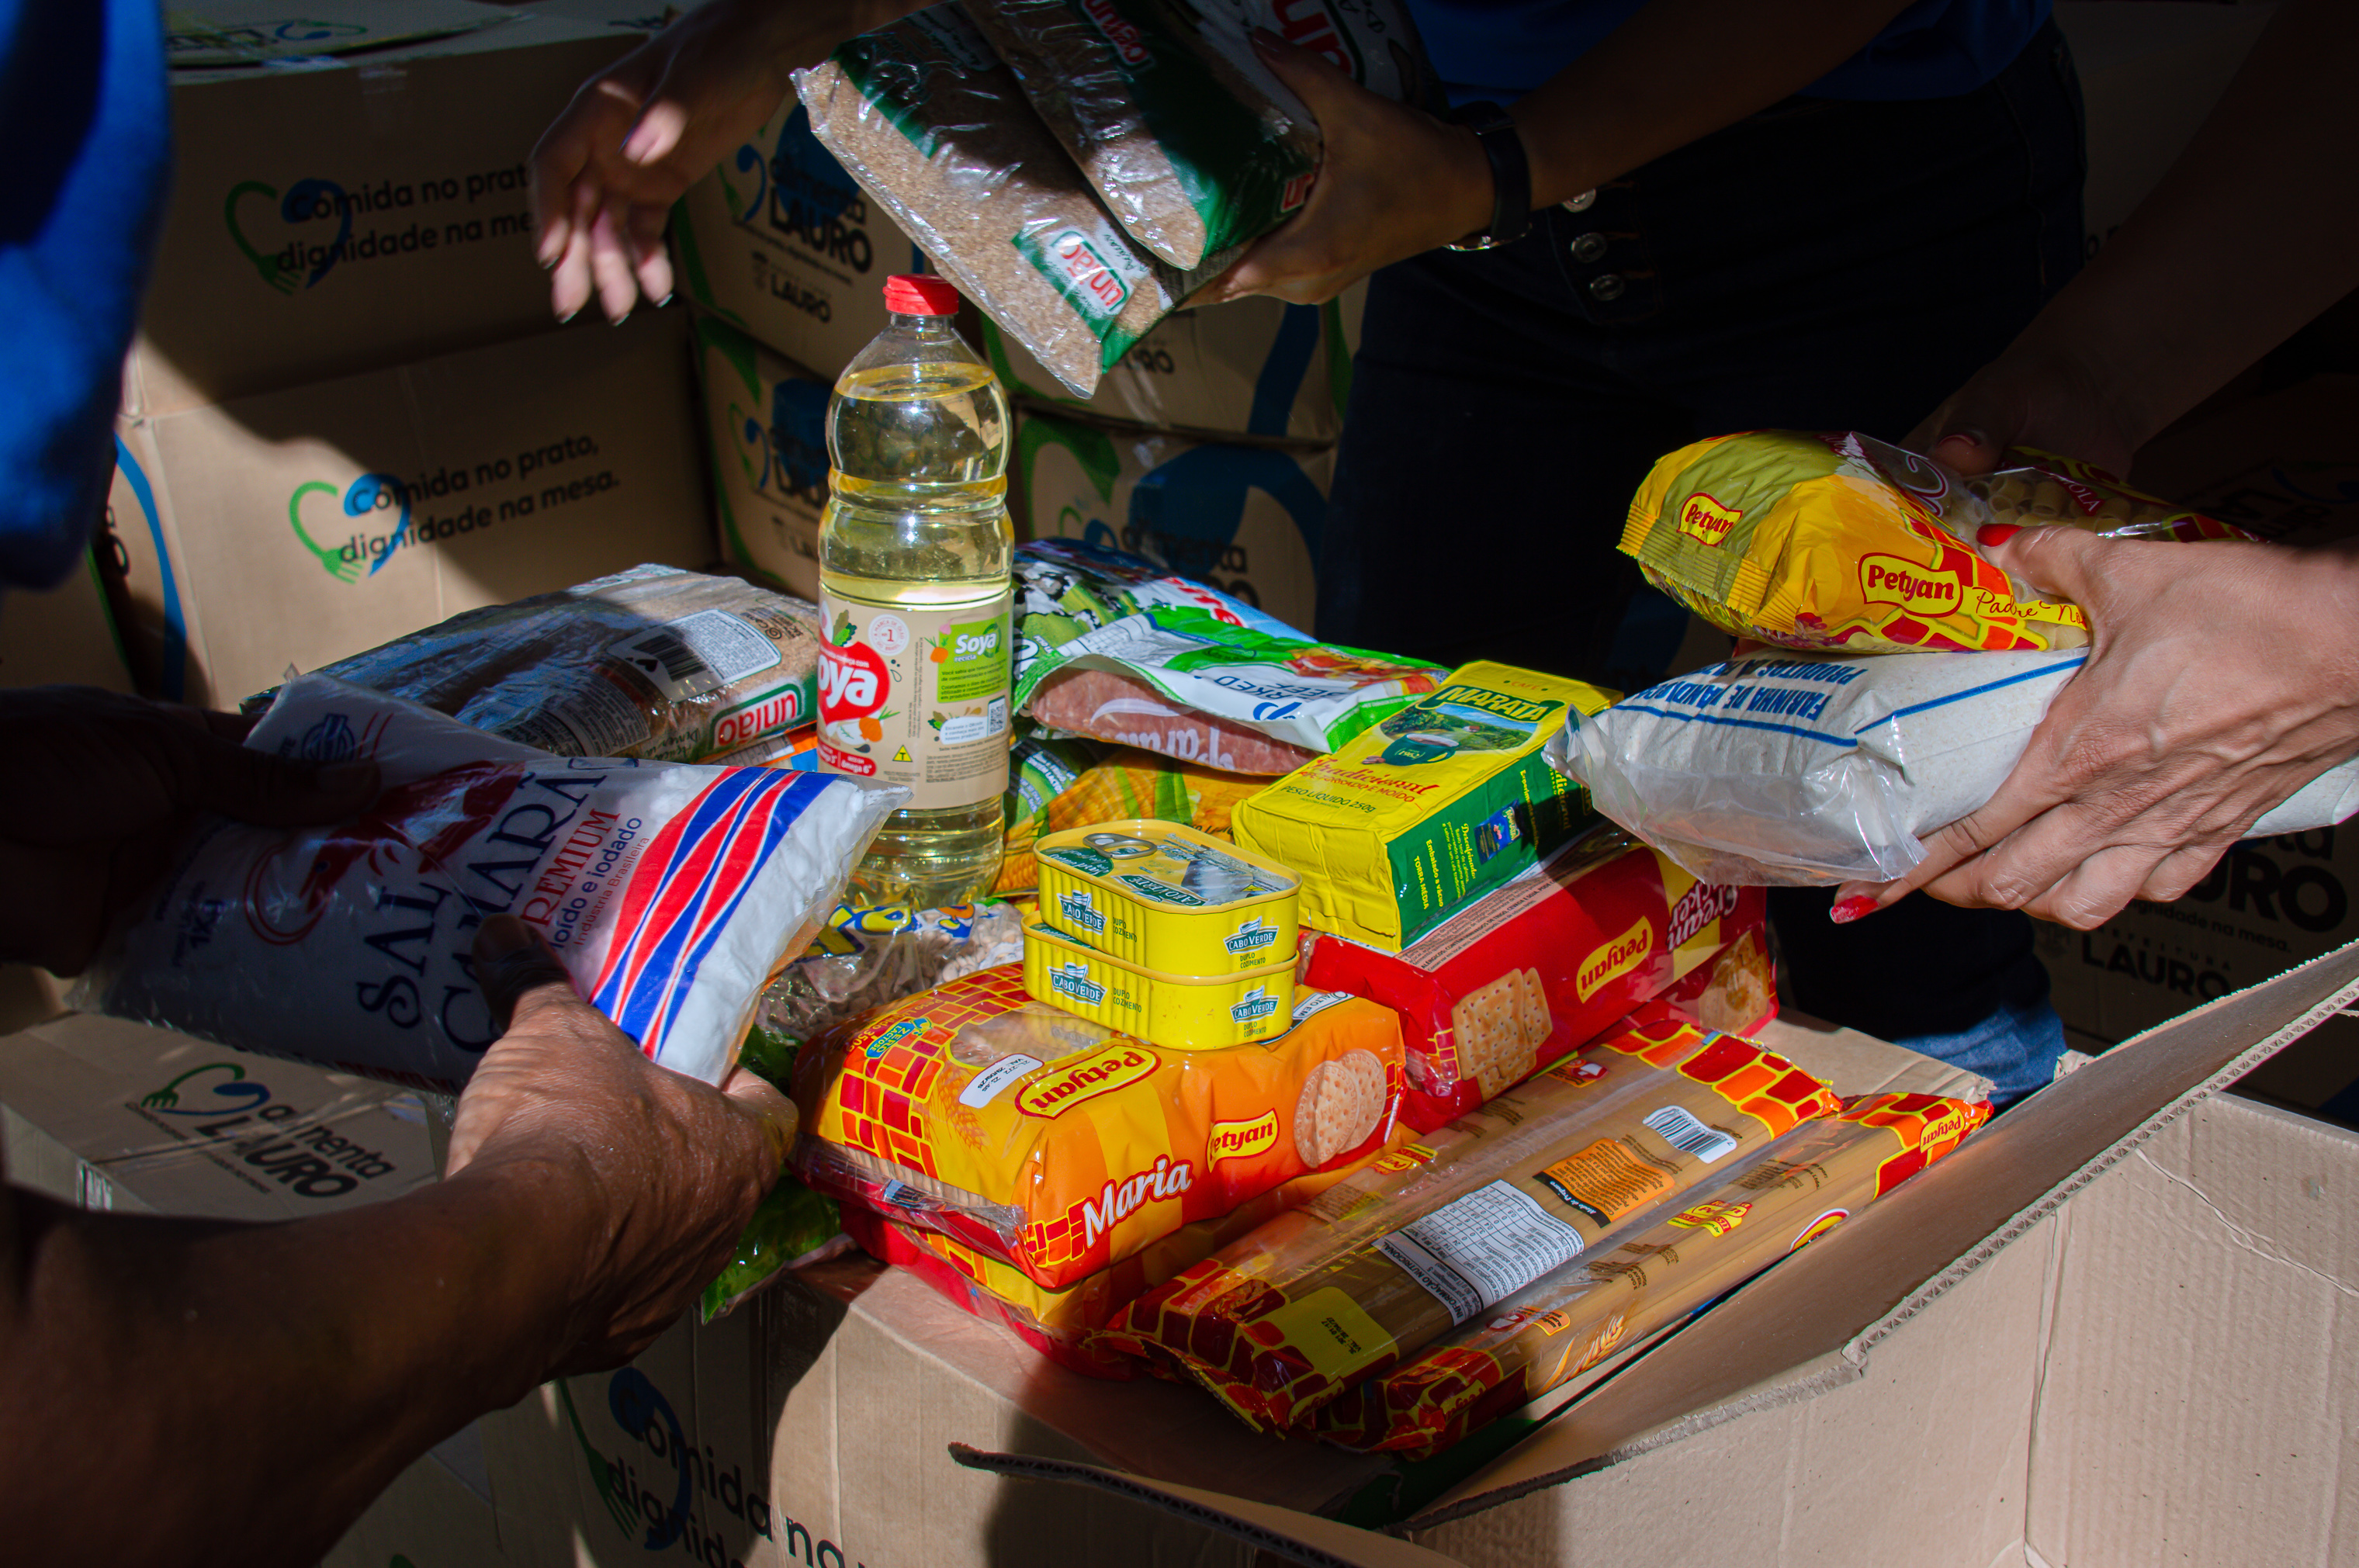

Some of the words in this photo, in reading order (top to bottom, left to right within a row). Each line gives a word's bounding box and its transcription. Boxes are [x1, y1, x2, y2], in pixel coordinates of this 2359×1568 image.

[289, 178, 414, 223] Comida
[422, 176, 459, 204] no
[466, 164, 528, 201] prat
[276, 222, 438, 273] dignidade
[445, 218, 483, 245] na
[770, 186, 874, 274] LAURO
[352, 466, 469, 517] Comida
[474, 454, 512, 485] no
[516, 431, 601, 479] prato,
[338, 504, 493, 566] dignidade
[498, 495, 536, 523] na
[540, 468, 621, 512] mesa.
[1869, 564, 1955, 602] Petyan
[954, 632, 999, 656] Soya
[954, 654, 977, 663] recicla
[817, 653, 878, 709] oya
[1214, 676, 1293, 700] RKED
[1723, 684, 1755, 710] DE
[718, 693, 798, 746] união
[1747, 687, 1832, 722] FARINHA
[1311, 757, 1439, 796] Tradicional
[1281, 785, 1308, 796] PESO
[1308, 789, 1352, 808] LÍQUIDO
[1351, 800, 1377, 815] 250g
[1378, 786, 1416, 803] MOÍDO
[519, 808, 622, 928] REMIUM
[547, 905, 587, 950] oído
[582, 881, 598, 894] e
[594, 816, 643, 879] iodado
[1414, 856, 1424, 882] TORRA
[1419, 884, 1429, 909] MÉDIA
[1426, 840, 1437, 877] Embalado
[1435, 884, 1443, 906] vácuo
[573, 889, 614, 946] Indústria
[611, 836, 651, 888] Brasileira
[1112, 916, 1127, 929] DUPLO
[1112, 926, 1138, 943] COZIMENTO
[356, 882, 453, 1030] SAL
[1239, 952, 1256, 962] DUPLO
[1240, 957, 1266, 969] COZIMENTO
[1581, 927, 1648, 992] Petyan
[2081, 936, 2232, 1001] LAURO
[1112, 987, 1131, 1001] DUPLO
[1113, 996, 1142, 1013] COZIMENTO
[870, 1022, 902, 1054] LACTOSE
[876, 1026, 910, 1054] ZERO
[1243, 1022, 1258, 1031] DUPLO
[1243, 1026, 1267, 1038] COZIMENTO
[1029, 1050, 1148, 1109] Petyan
[1921, 1113, 1963, 1148] Petyan
[194, 1116, 358, 1197] LURO
[1083, 1162, 1193, 1248] Maria
[1550, 1180, 1570, 1200] Preparo
[1430, 1232, 1439, 1241] 211
[1443, 1242, 1452, 1251] 114
[1556, 1235, 1567, 1246] (mg)
[1384, 1244, 1422, 1276] NUTRICIONAL
[1509, 1263, 1523, 1282] Açúcares
[1475, 1268, 1497, 1289] energético
[1502, 1269, 1516, 1289] Açúcares
[1423, 1277, 1460, 1317] INFORMAÇÃO
[608, 1456, 745, 1568] dignid
